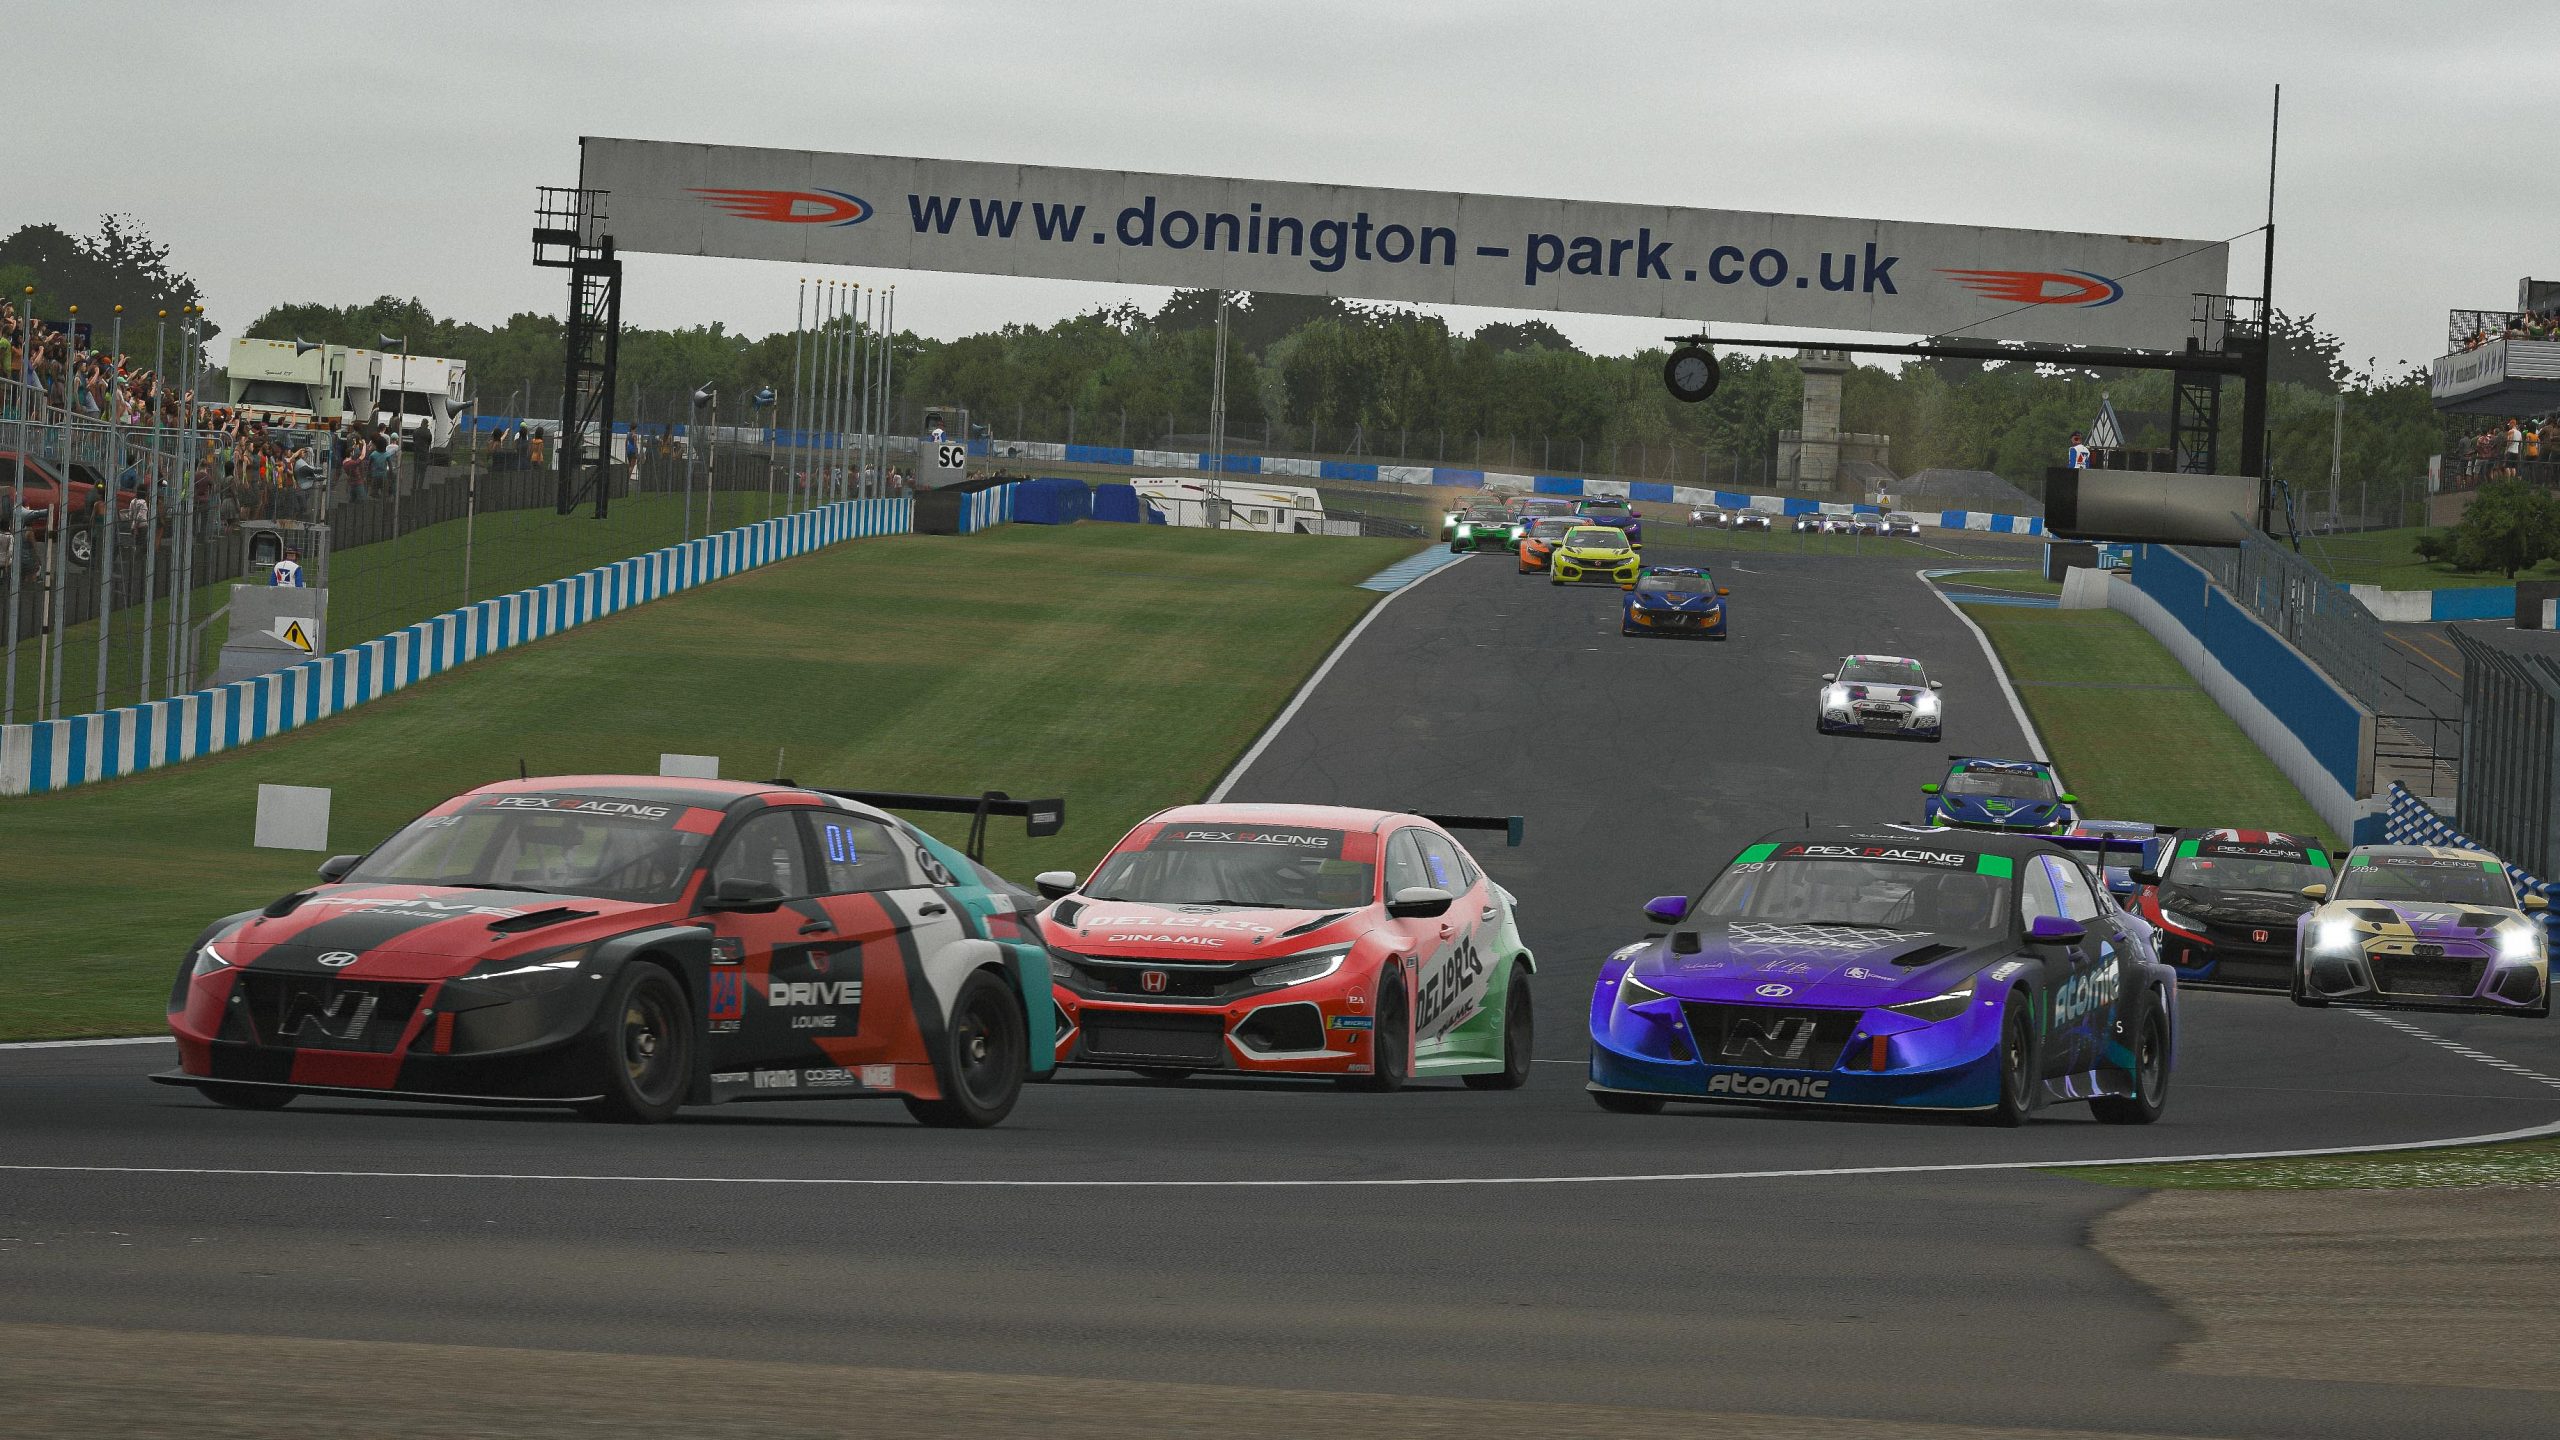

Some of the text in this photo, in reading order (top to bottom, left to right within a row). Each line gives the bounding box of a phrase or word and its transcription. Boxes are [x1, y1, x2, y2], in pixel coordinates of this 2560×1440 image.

[939, 446, 964, 468] SC
[479, 796, 560, 808] APEX
[556, 799, 671, 818] RACING
[1166, 831, 1330, 847] APEX RACING
[1784, 844, 1967, 864] APEX RACING
[2206, 844, 2301, 858] APEX RACING
[1731, 862, 1778, 874] 291
[2350, 865, 2379, 873] 289
[341, 907, 450, 919] LOUNGE
[1108, 934, 1227, 947] DINAMIC
[769, 981, 862, 1007] DRIVE
[791, 1015, 838, 1029] LOUNGE
[804, 1068, 854, 1081] COBRA
